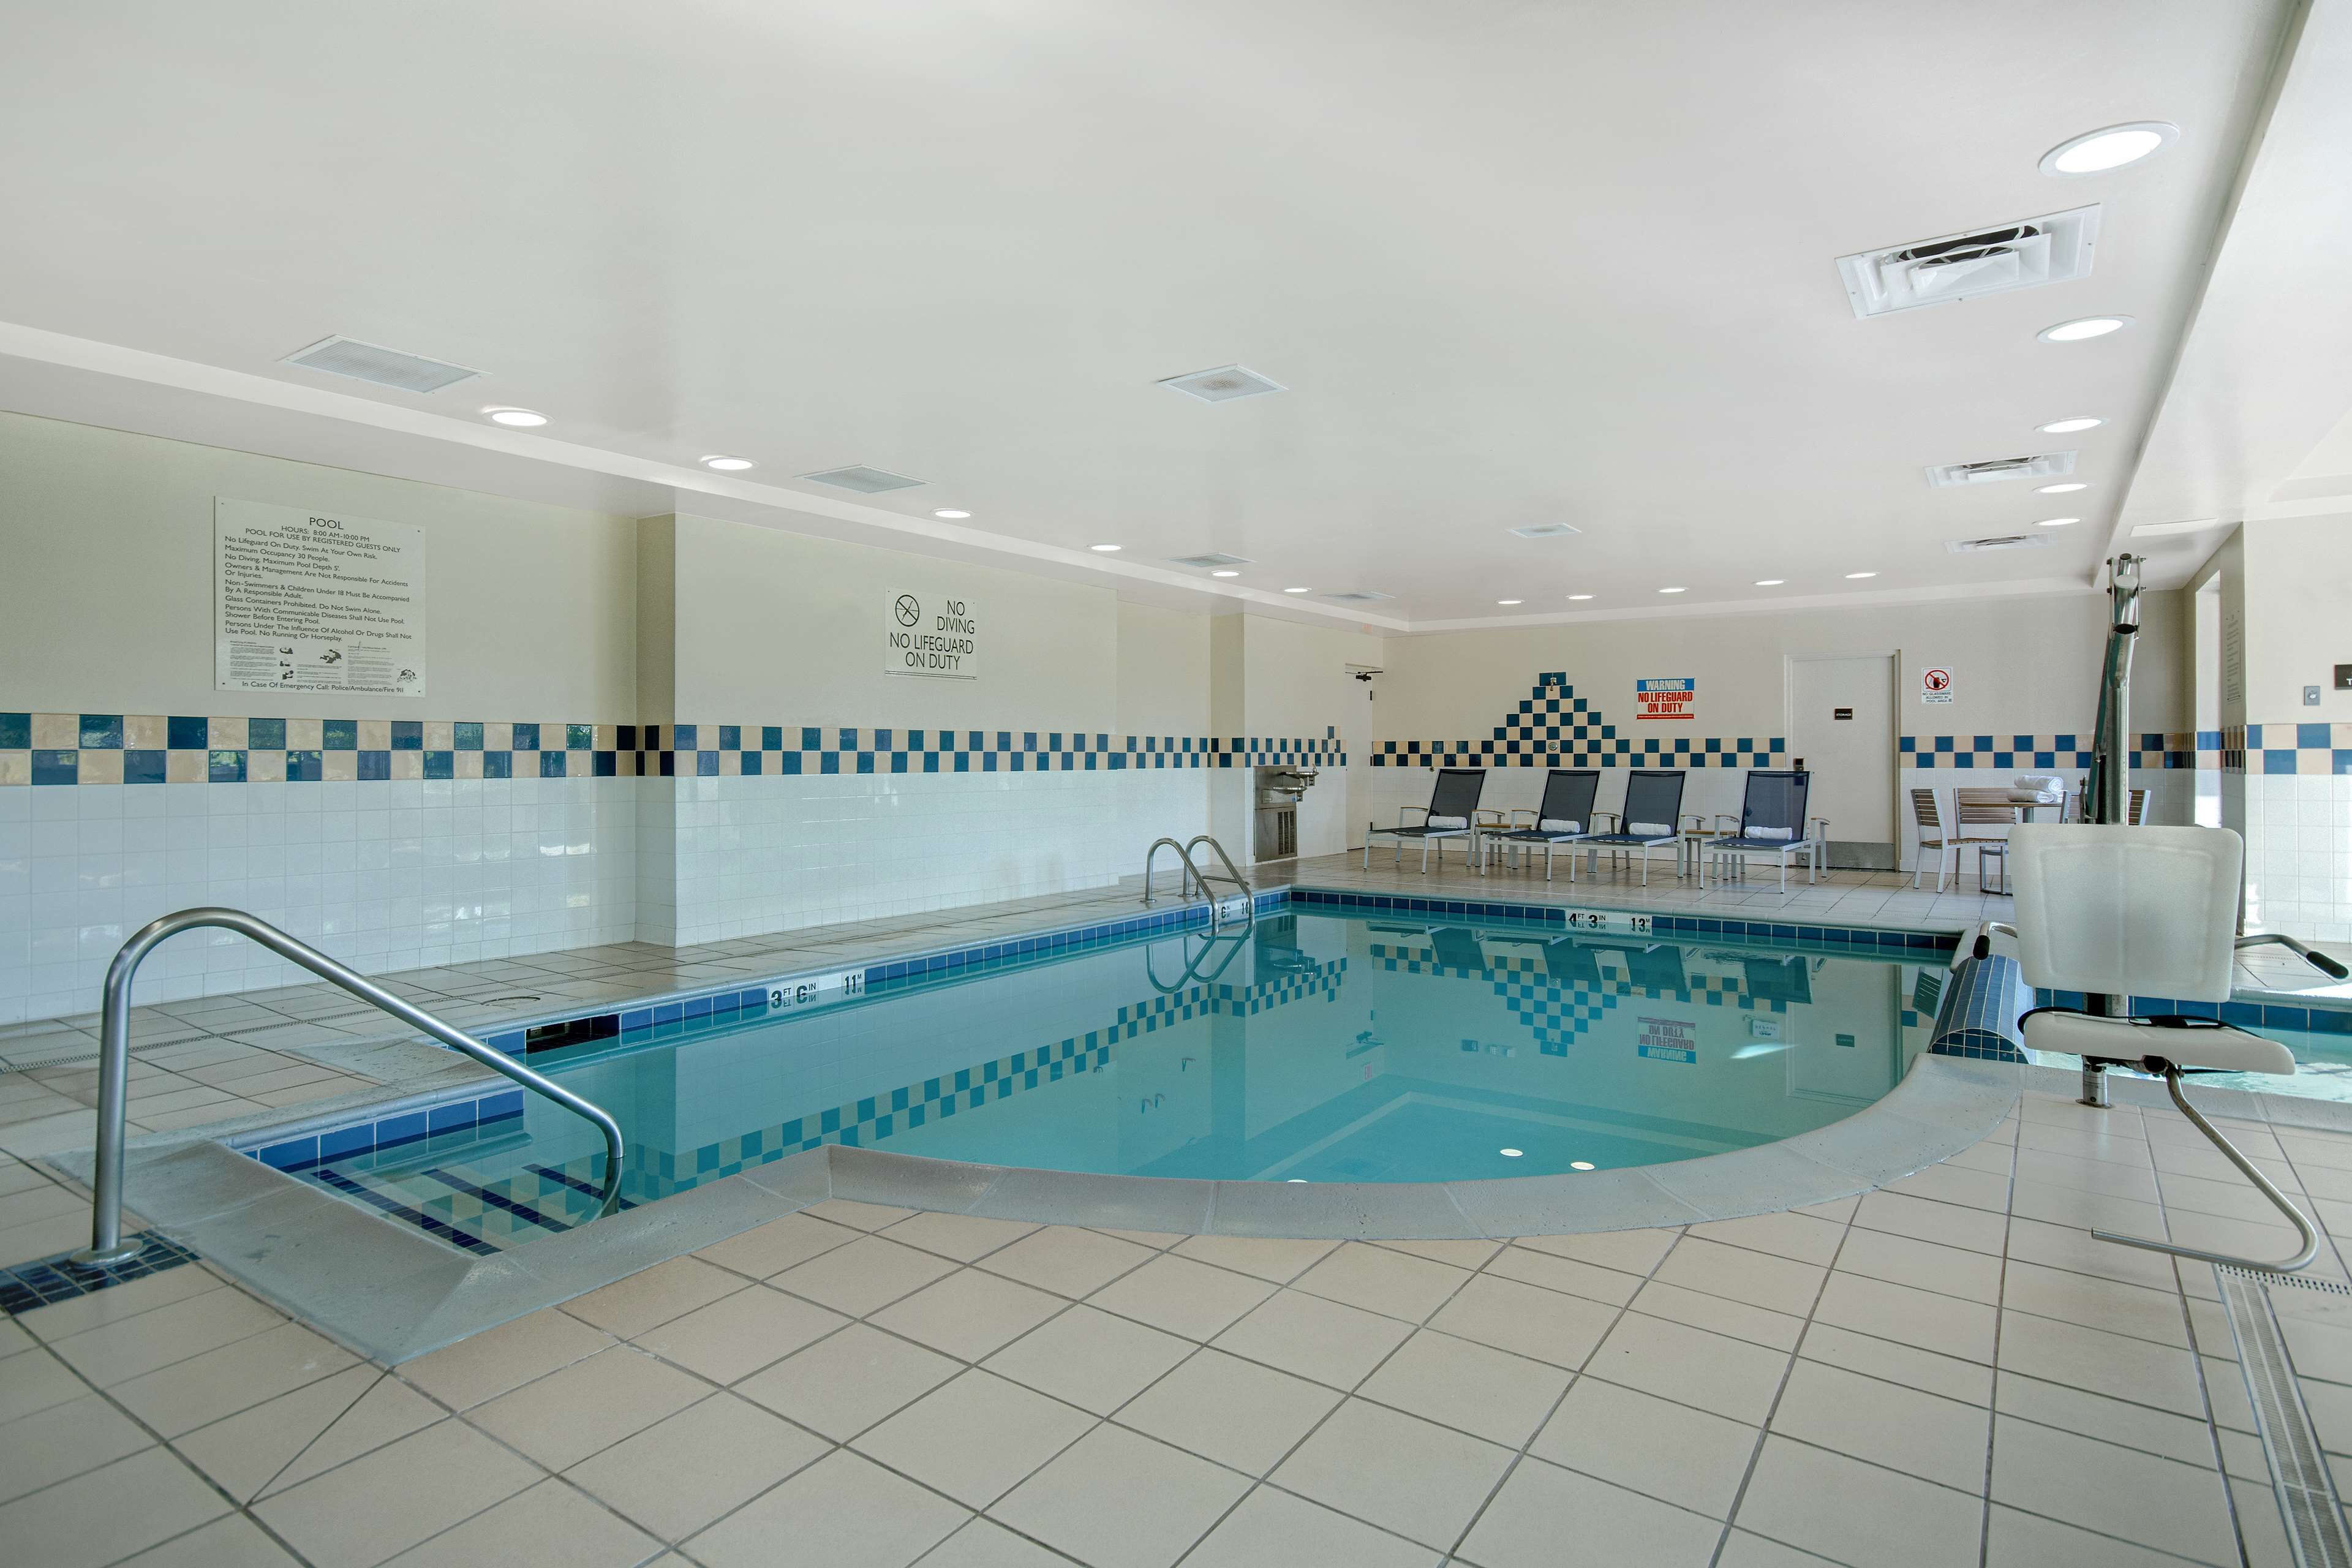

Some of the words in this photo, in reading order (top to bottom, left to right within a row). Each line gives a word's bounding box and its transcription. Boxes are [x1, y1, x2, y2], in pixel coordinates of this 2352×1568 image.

[309, 517, 344, 530] POOL
[281, 526, 309, 534] HOURS:
[238, 537, 268, 546] Lifeguard
[312, 537, 354, 546] REGISTERED
[225, 545, 258, 553] Maximum
[260, 549, 295, 559] Occupancy
[263, 557, 295, 566] Maximum
[262, 566, 303, 575] Management
[333, 573, 368, 582] Responsible
[225, 579, 278, 589] Non-Swimmers
[371, 594, 409, 602] Accompanied
[244, 588, 282, 597] Responsible
[245, 597, 281, 605] Containers
[273, 608, 319, 617] Communicable
[947, 600, 965, 616] NO
[276, 615, 303, 624] Entering
[937, 616, 974, 634] DIVING
[272, 631, 298, 639] Running
[890, 632, 910, 648] NO
[914, 635, 973, 654] LIFEGUARD
[906, 652, 925, 667] ON
[929, 654, 960, 670] DUTY
[1646, 680, 1685, 690] WARNING
[1638, 692, 1649, 703] NO
[1651, 692, 1693, 702] LIFEGUARD
[1648, 703, 1659, 713] ON
[1662, 703, 1683, 712] DUTY
[783, 987, 791, 996] FT
[809, 982, 816, 991] IN
